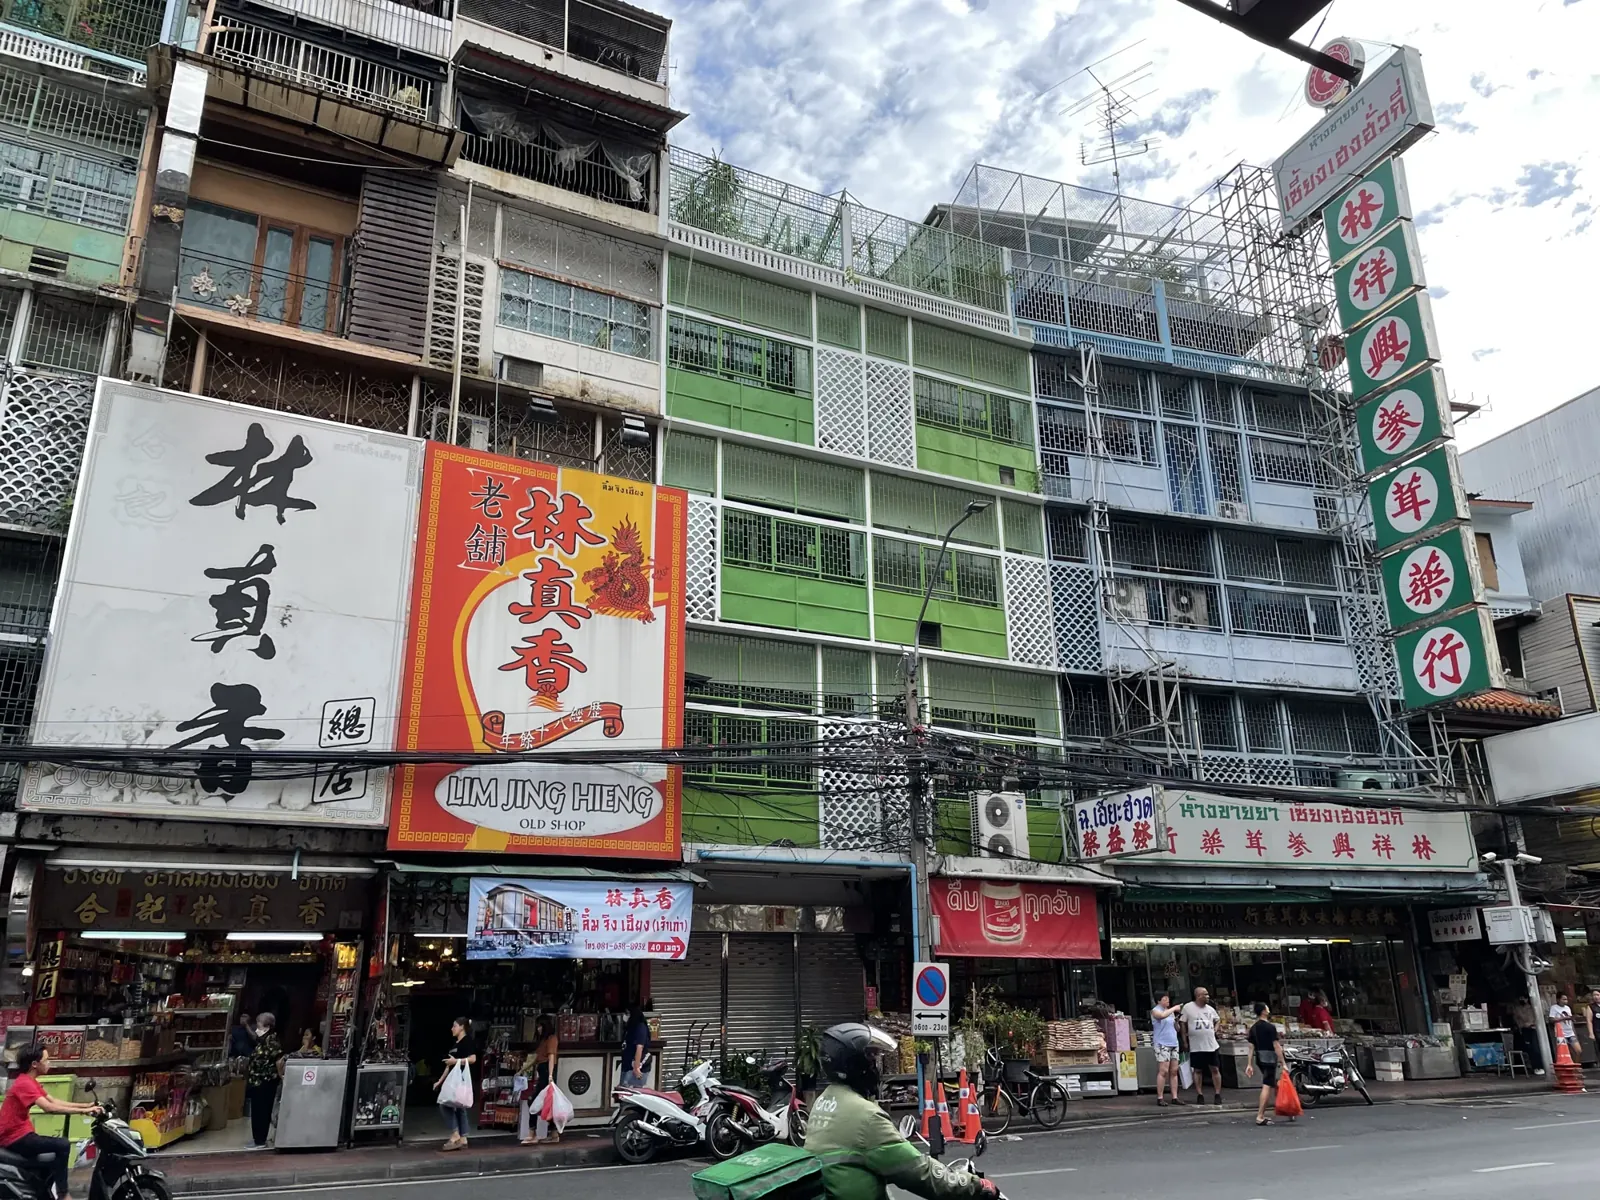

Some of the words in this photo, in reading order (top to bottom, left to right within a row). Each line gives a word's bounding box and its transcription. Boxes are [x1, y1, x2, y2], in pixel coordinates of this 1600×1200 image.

[1308, 96, 1365, 151] ห้างขายยา
[496, 486, 610, 694] 林真香
[446, 776, 498, 808] LIM
[501, 778, 567, 815] JING
[572, 782, 654, 818] HIENG
[1179, 795, 1280, 822] ห้างขายยา
[519, 818, 546, 830] OLD
[550, 818, 586, 832] SHOP
[604, 886, 676, 911] 林真香
[946, 879, 980, 912] ดื่ม
[1024, 888, 1081, 922] ทุกวัน
[581, 907, 599, 932] ลิ้ม
[603, 914, 618, 932] จิง
[620, 913, 651, 933] เฮียง
[650, 943, 662, 952] 40
[815, 1095, 838, 1113] Grab
